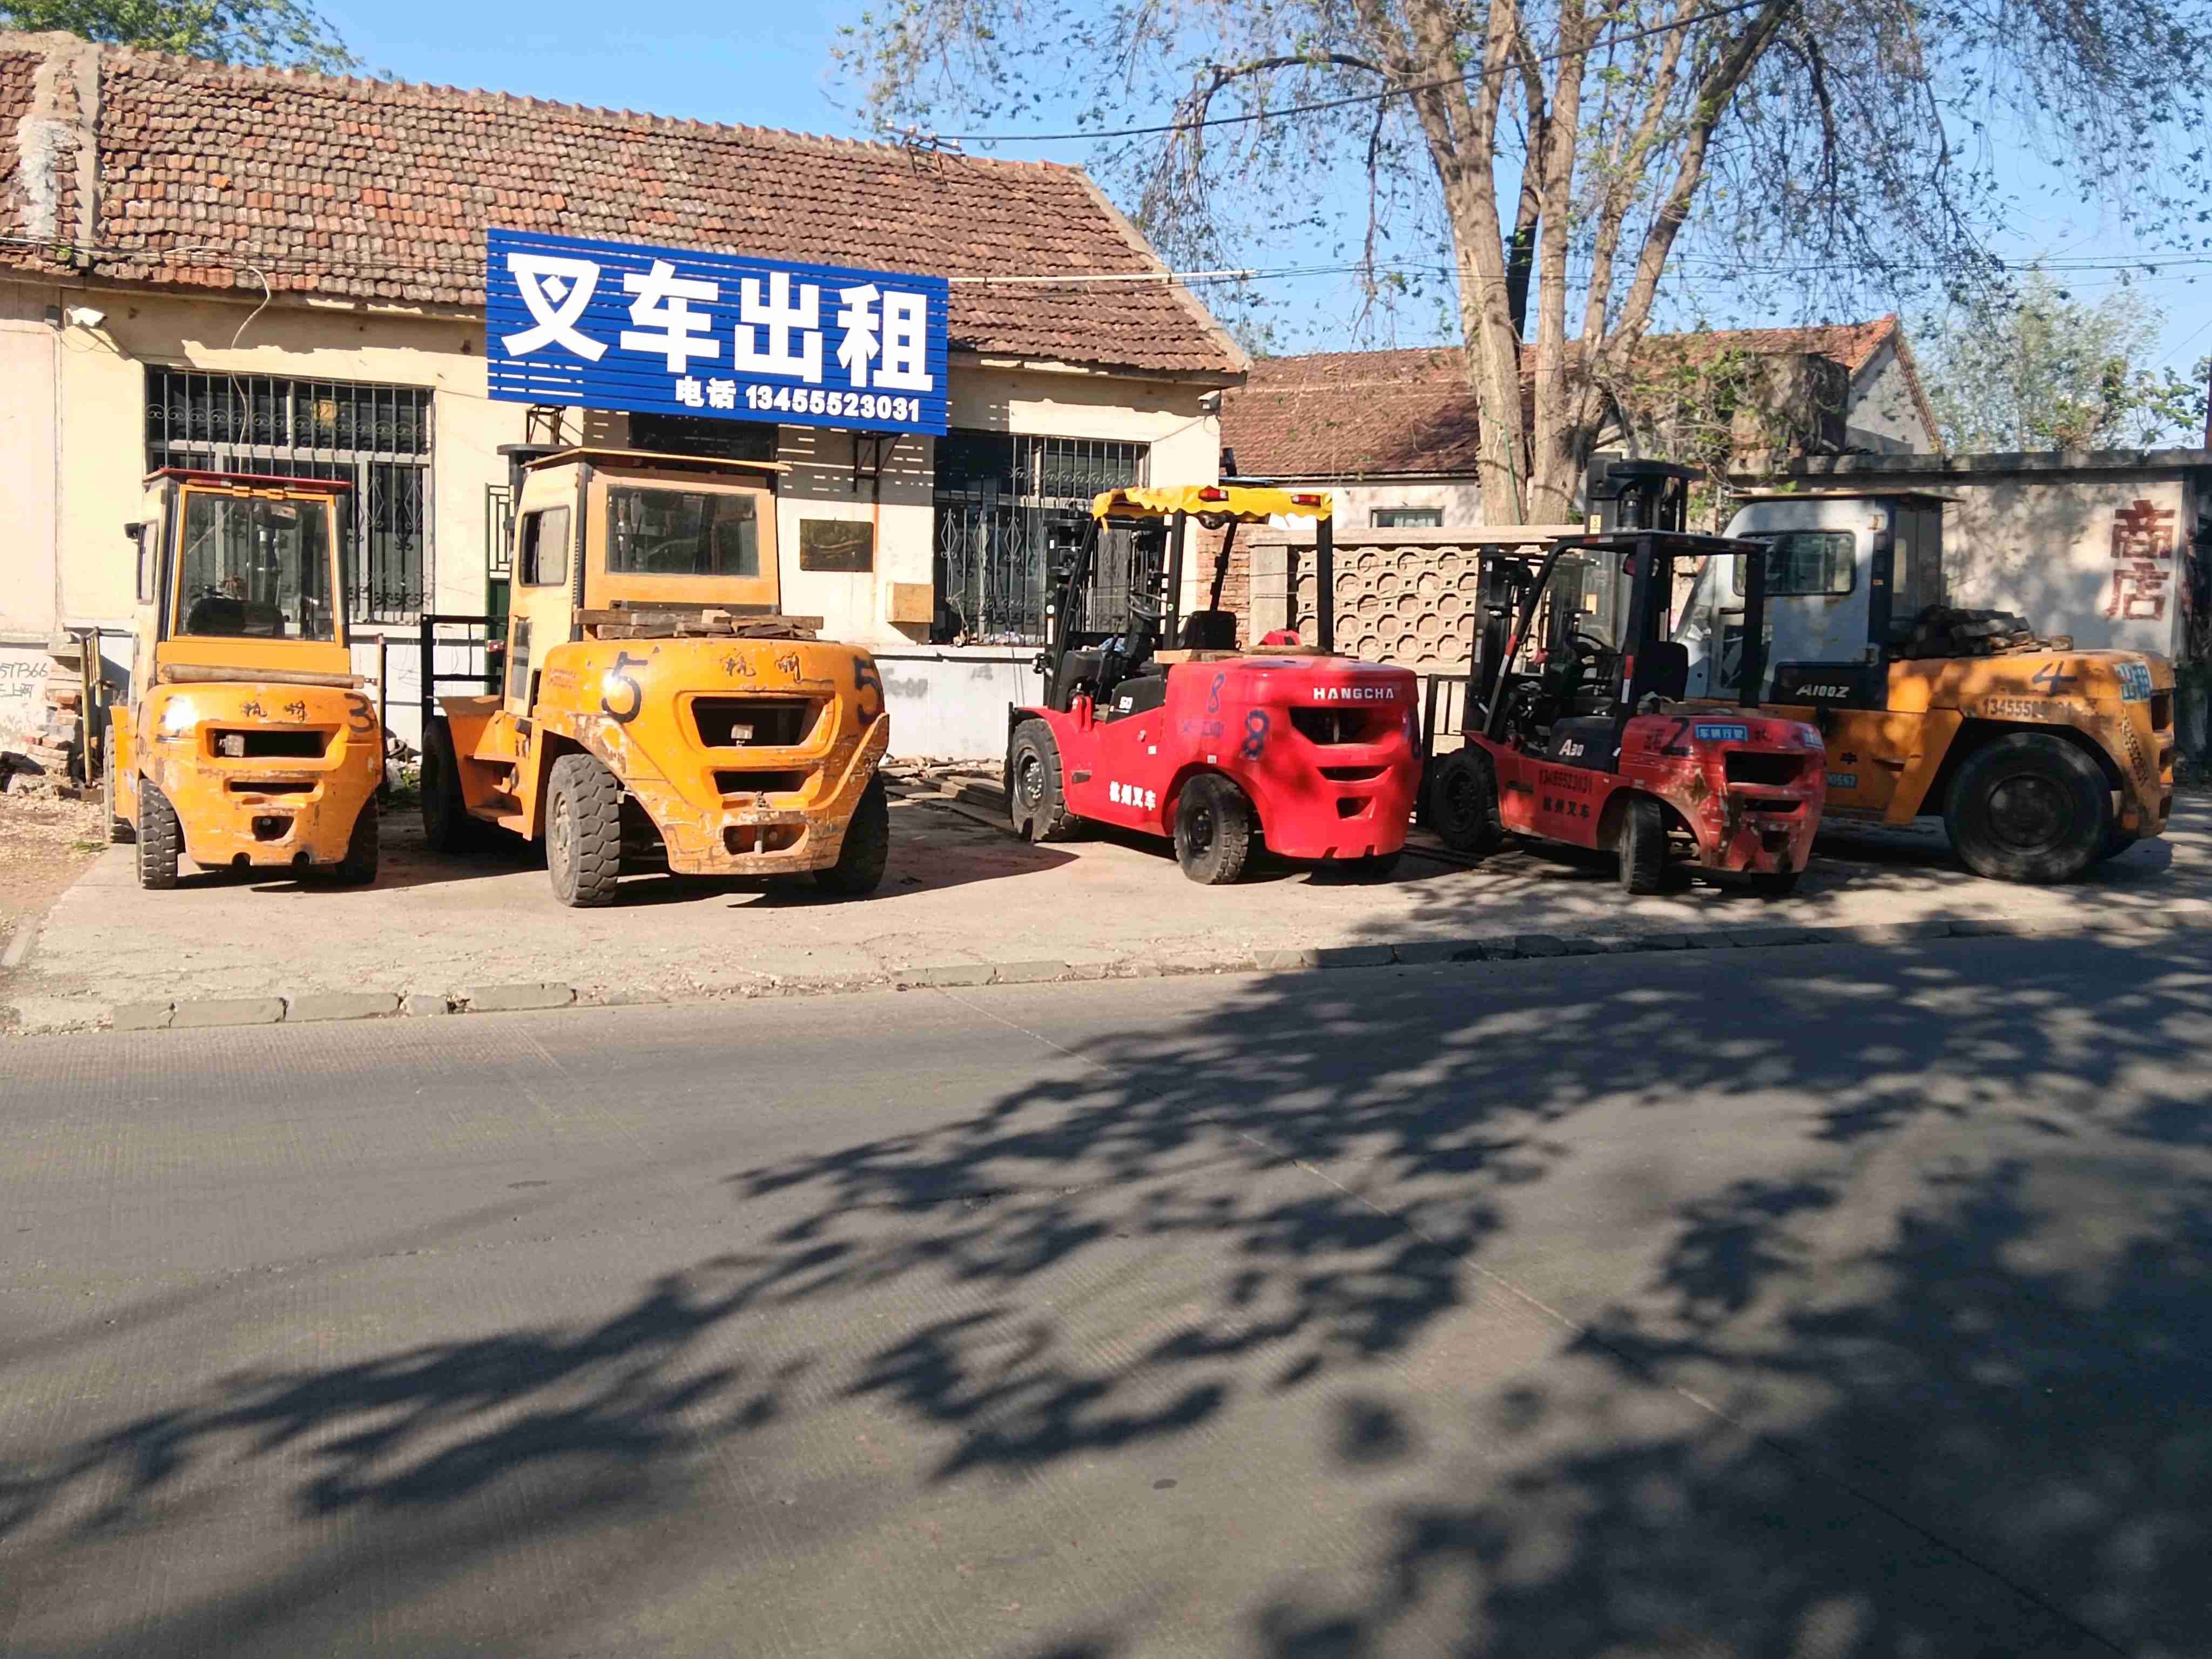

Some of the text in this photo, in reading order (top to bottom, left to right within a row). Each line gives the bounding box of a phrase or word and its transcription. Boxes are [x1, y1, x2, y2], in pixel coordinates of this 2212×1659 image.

[501, 252, 933, 392] 叉车出租
[676, 376, 919, 422] 电话 13455523031
[2105, 500, 2175, 622] 商店
[601, 651, 648, 723] 5
[853, 656, 885, 725] 5
[1313, 686, 1394, 700] HANGCHA
[1796, 684, 1850, 698] A100Z
[2032, 661, 2078, 696] 4
[344, 693, 375, 733] 3
[1245, 710, 1272, 757] 8
[1559, 739, 1584, 756] A30
[1660, 717, 1690, 756] 2
